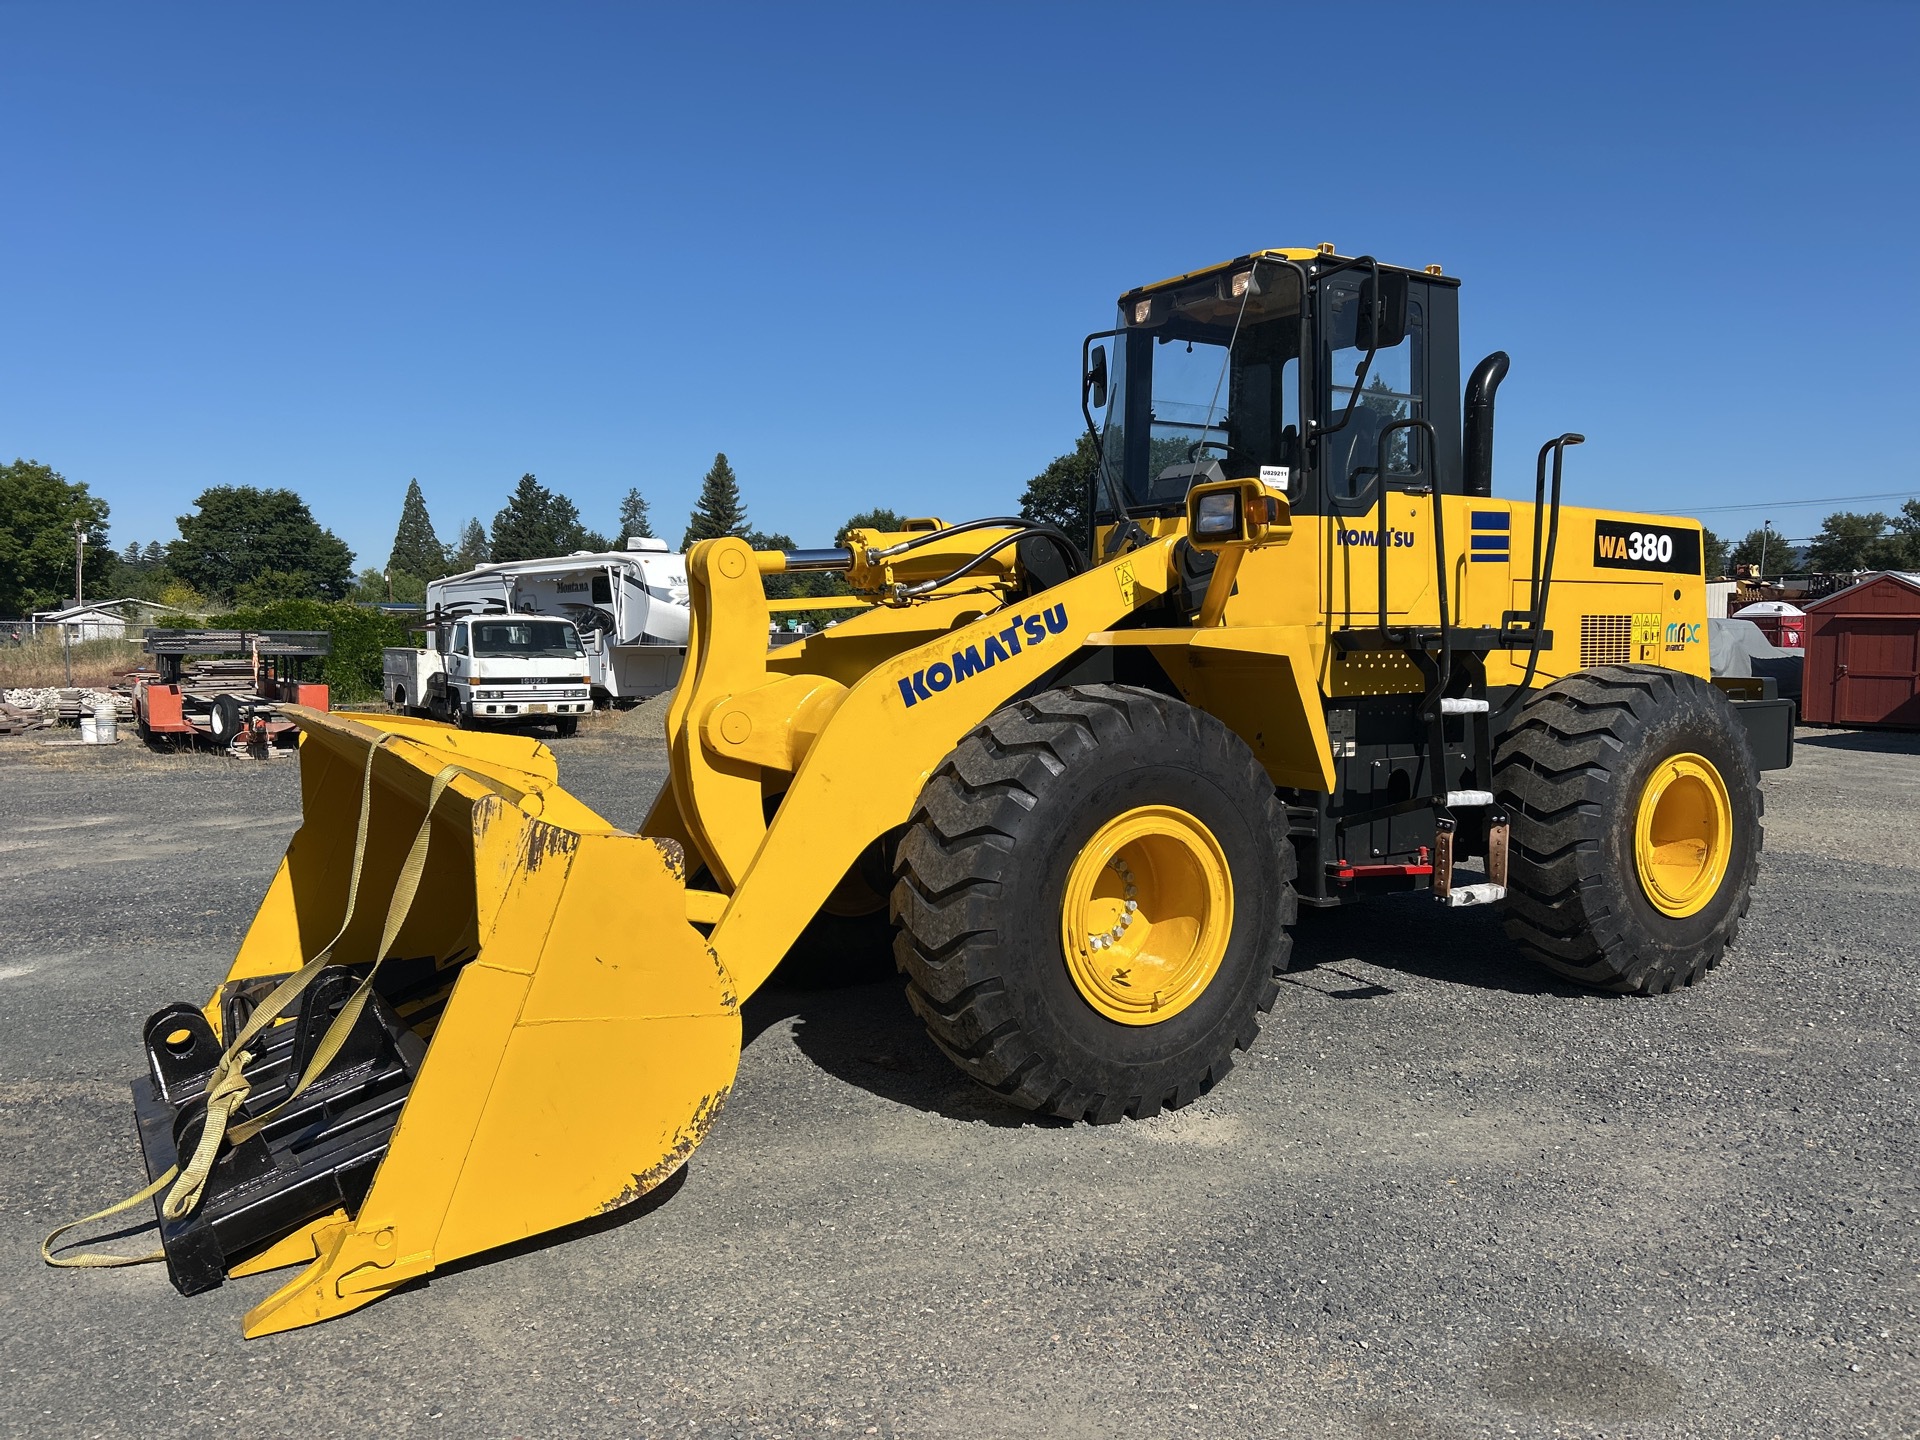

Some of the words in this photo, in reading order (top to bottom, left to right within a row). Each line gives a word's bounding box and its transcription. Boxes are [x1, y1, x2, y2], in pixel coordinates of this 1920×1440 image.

[1598, 531, 1673, 563] WA380
[556, 581, 589, 593] Montana
[897, 602, 1069, 709] KOMATSU
[520, 677, 549, 685] ISUZU
